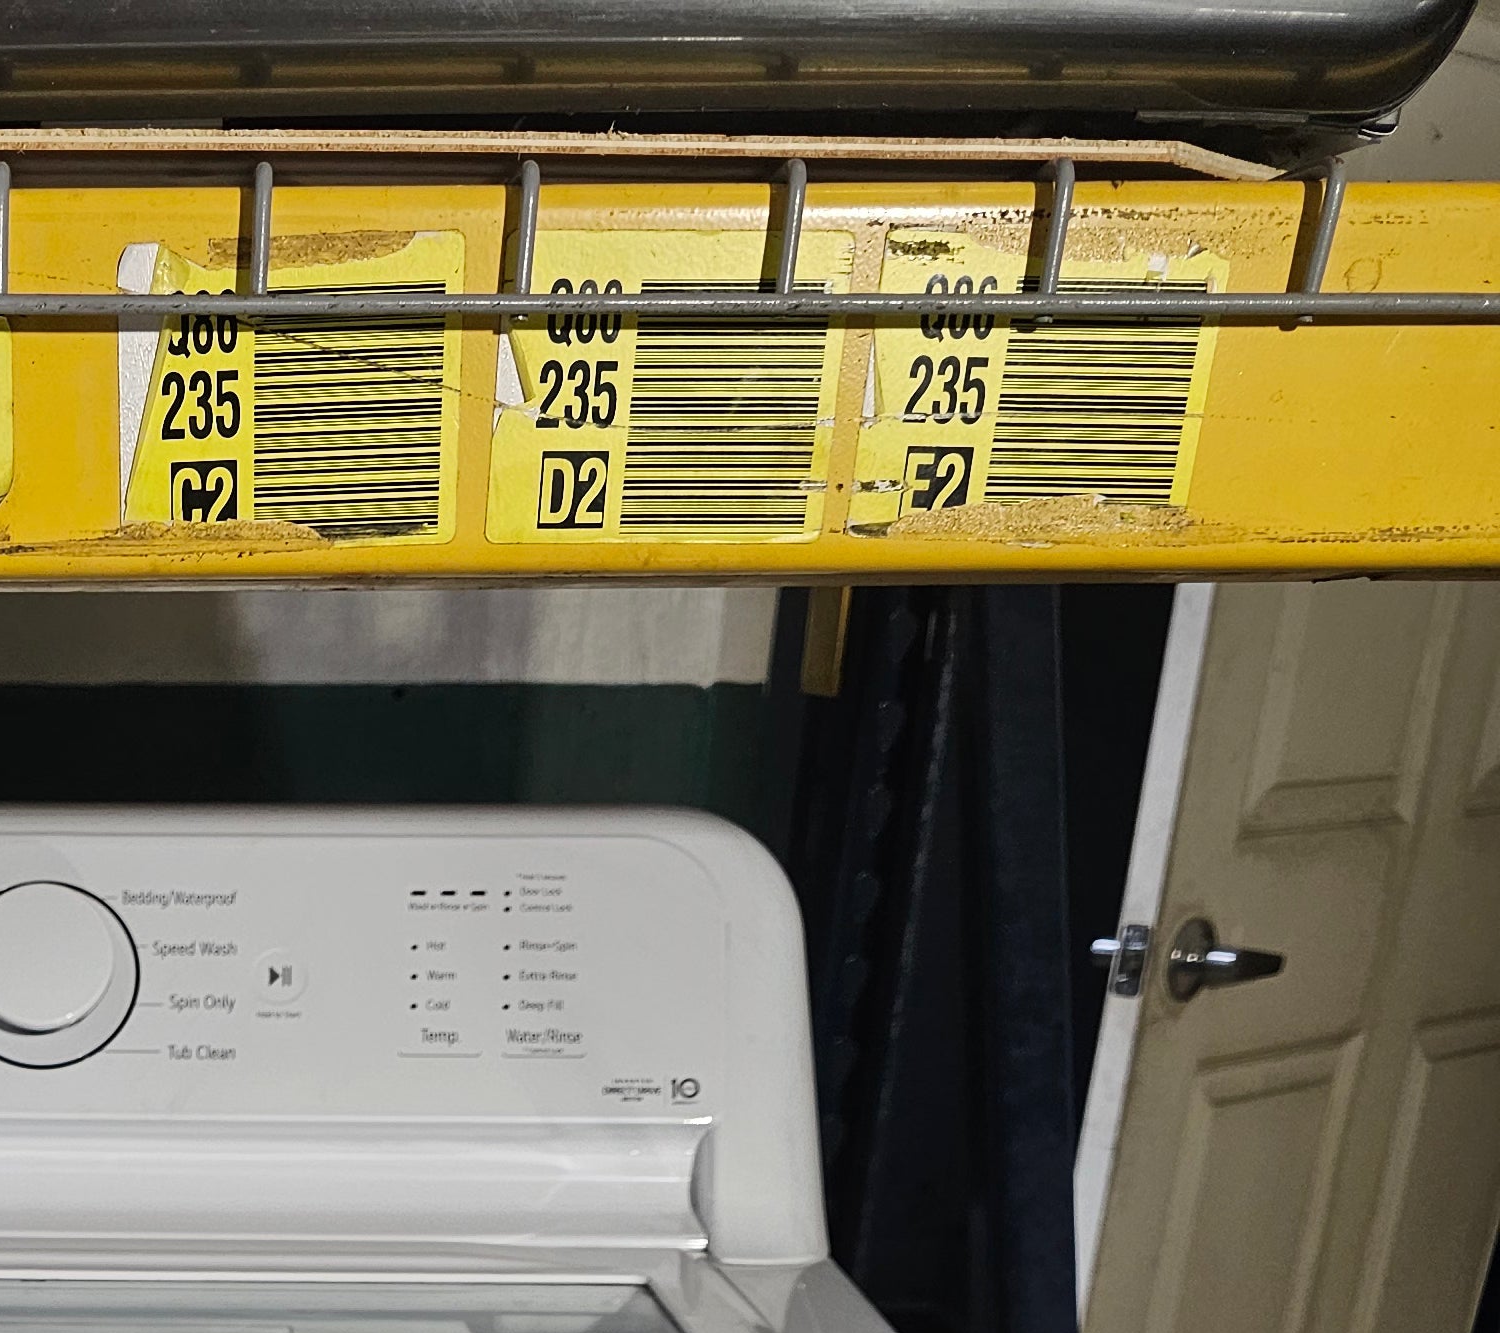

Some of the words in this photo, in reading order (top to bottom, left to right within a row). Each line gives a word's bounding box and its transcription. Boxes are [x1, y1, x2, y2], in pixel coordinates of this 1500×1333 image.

[162, 369, 241, 440] 235
[536, 359, 618, 430] 235
[903, 355, 989, 425] 235
[172, 466, 237, 522] C2
[540, 457, 608, 526] D2
[152, 939, 197, 960] Speed
[199, 939, 238, 956] Wash
[169, 993, 200, 1013] Spin
[203, 993, 237, 1014] Only
[168, 1043, 193, 1060] Tub
[195, 1043, 237, 1061] Clean
[505, 1028, 584, 1044] Water/Rinse
